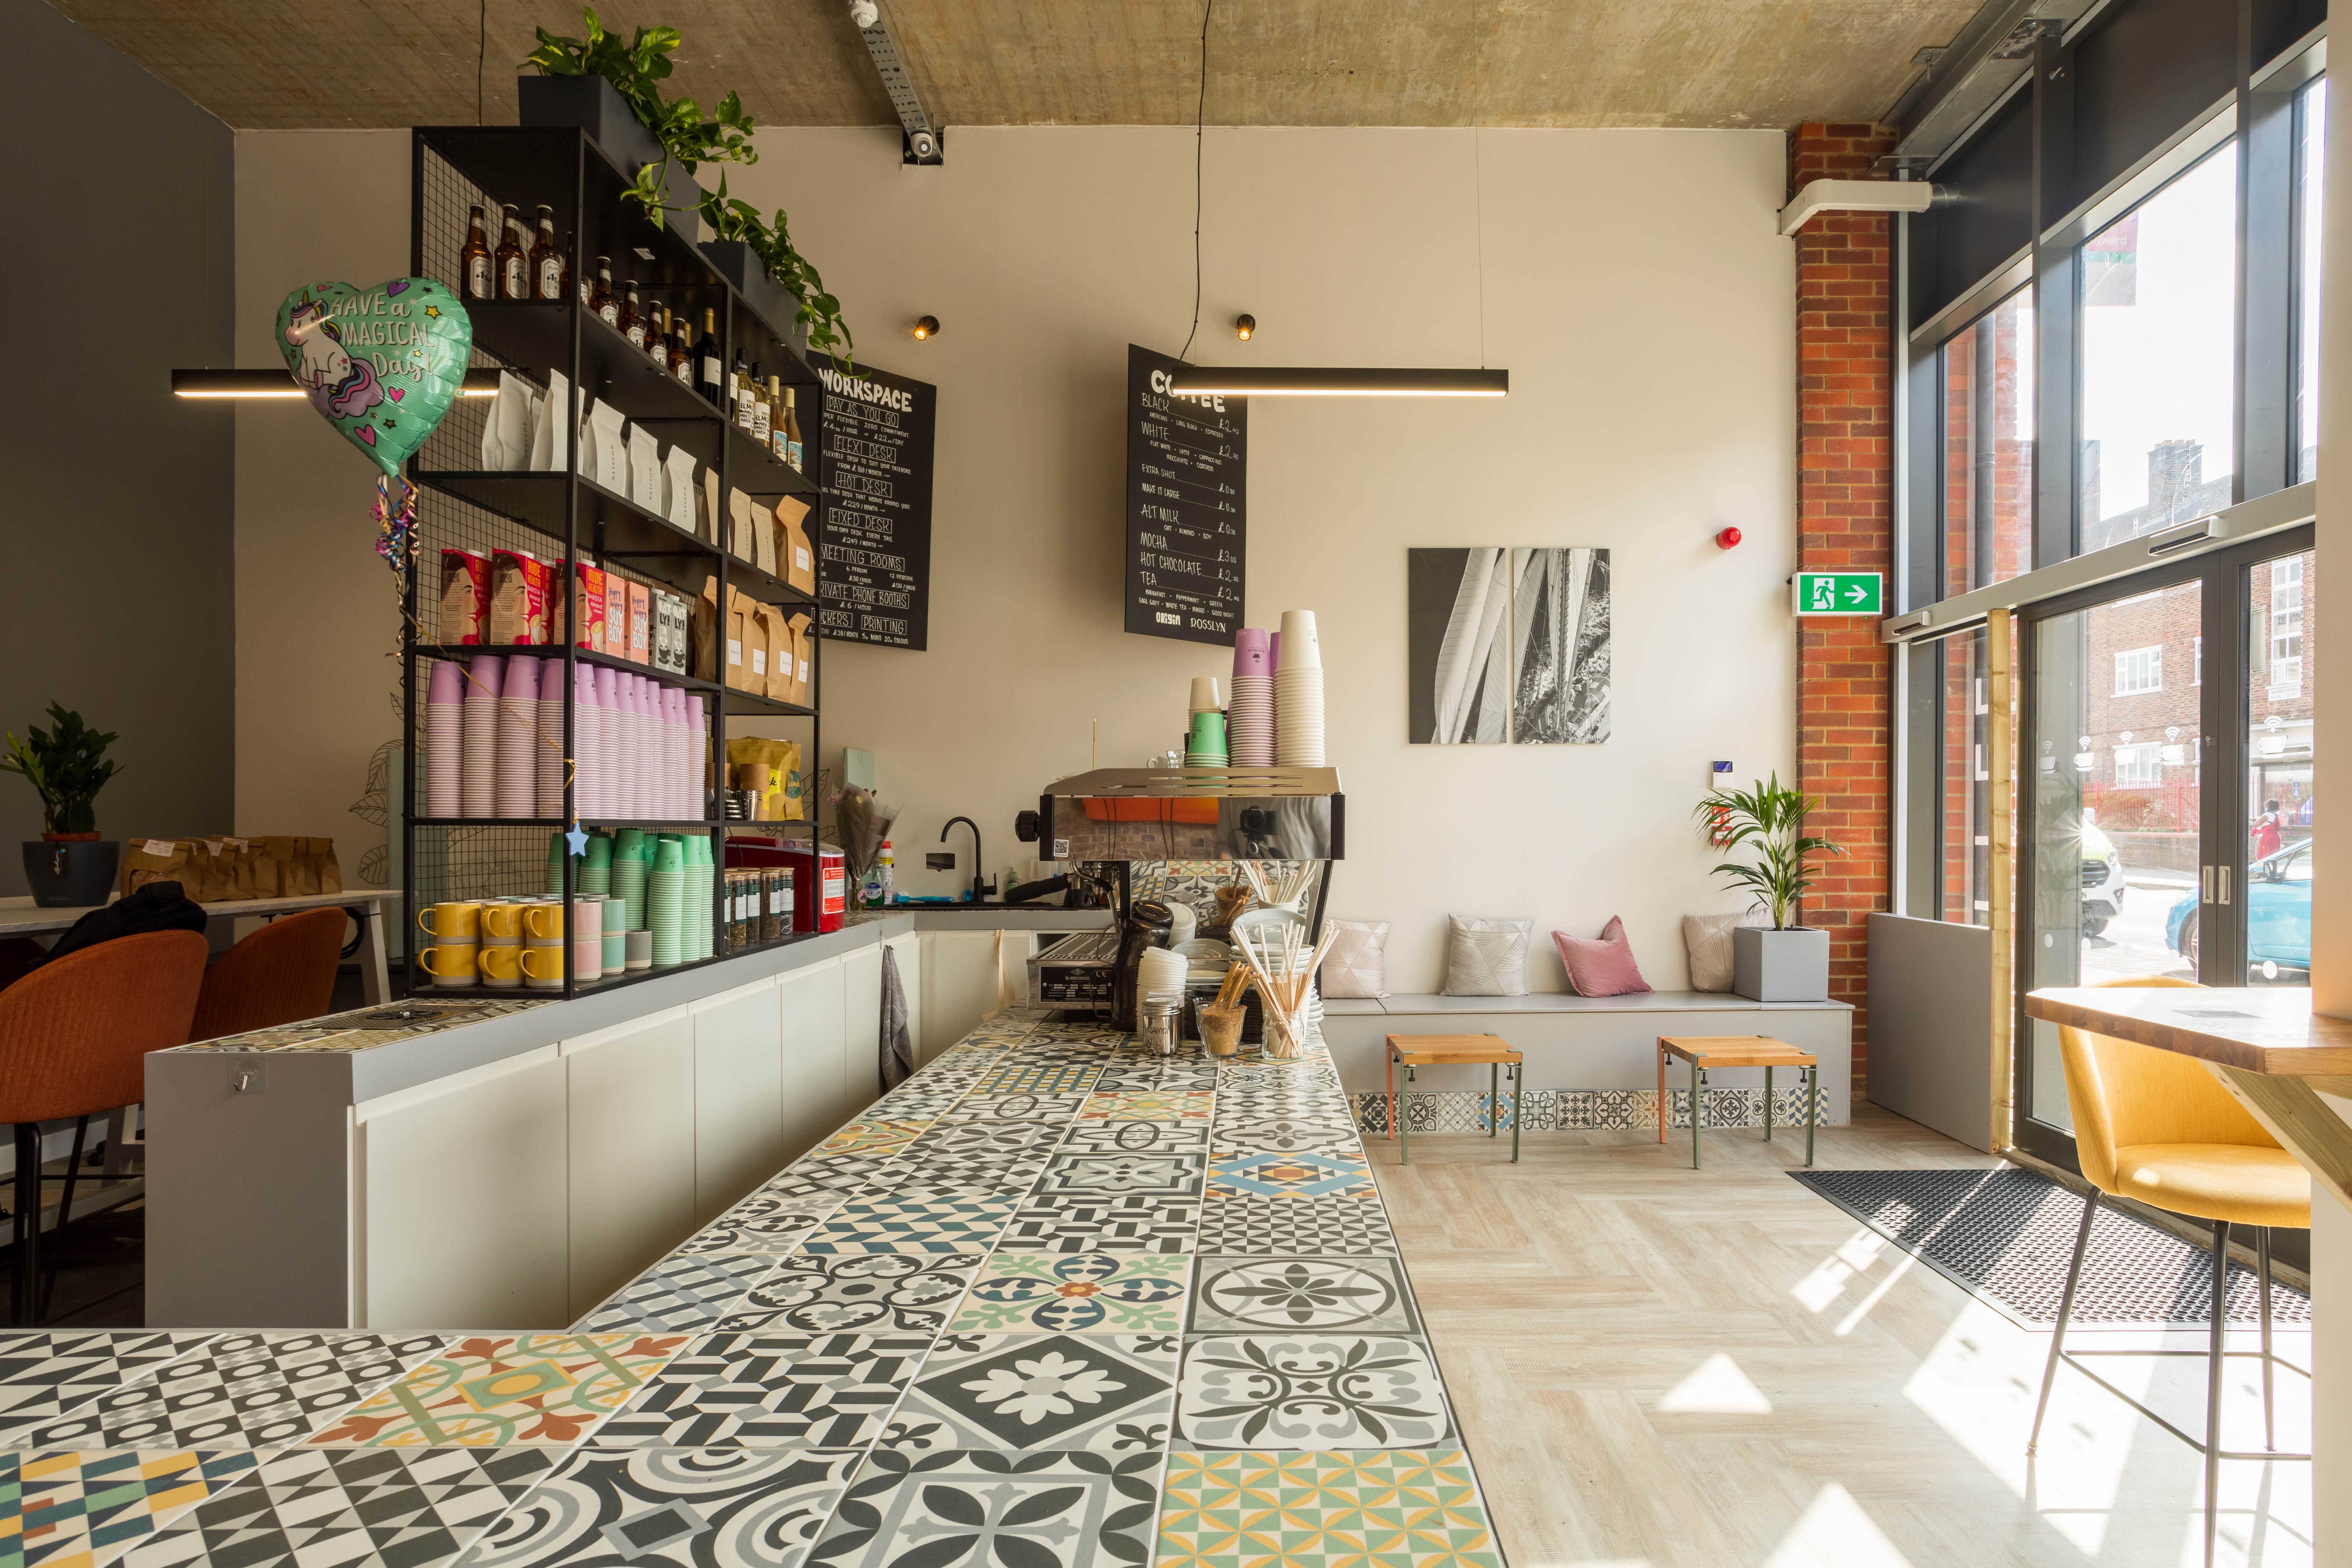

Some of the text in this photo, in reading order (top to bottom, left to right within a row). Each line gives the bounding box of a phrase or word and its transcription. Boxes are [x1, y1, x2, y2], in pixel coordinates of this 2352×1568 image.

[330, 292, 412, 317] HAVE a
[342, 321, 435, 348] MAGICAL
[372, 352, 433, 382] Day!
[818, 368, 912, 412] WORKSPACE
[1151, 370, 1225, 412] COEE
[829, 398, 896, 425] PAY AS YOU GO
[1141, 393, 1239, 434] BLACK £2.40
[881, 427, 909, 438] COMMITMENT.
[1150, 412, 1167, 422] AMERICANO
[1205, 428, 1223, 438] ESPRESSO
[837, 437, 893, 462] FLEXI DESK
[1142, 421, 1238, 459] WHITE £2.70
[823, 450, 844, 459] FLEXIBLE
[892, 465, 911, 475] CALENDAR
[1167, 454, 1213, 471] MACCHIATO CORTADO
[1199, 454, 1221, 465] CAPPUCCINO
[838, 474, 888, 496] HOT DESK
[1142, 464, 1235, 495] EXTRA SHOT £0.30
[843, 500, 860, 508] £229
[1142, 483, 1235, 513] MAKE IT LARGE £0.30
[832, 510, 889, 531] FIXED DESK
[1141, 504, 1235, 535] ALT MILK £0.30
[1179, 528, 1195, 536] ALMOND
[1141, 532, 1236, 563] MOCHA £3.00
[821, 546, 901, 570] MEETING ROOMS
[1141, 551, 1238, 582] HOT CHOCOLATE £2.70
[528, 560, 541, 578] RUDE
[589, 569, 603, 585] RUDE
[528, 574, 541, 588] HEALTH
[528, 585, 540, 595] BARISTA
[588, 583, 602, 595] HEALTH
[1140, 571, 1239, 601] TEA £2.40
[529, 594, 541, 602] Almond
[588, 593, 602, 603] BARISTA
[609, 587, 621, 602] Happy
[632, 596, 644, 610] Happy
[821, 582, 906, 607] RIVATE PHONE BOOTHS
[1145, 589, 1165, 597] BREAKFAST
[1176, 594, 1199, 603] PEPPERMINT
[590, 601, 602, 609] Almond
[610, 598, 622, 614] happy
[634, 607, 646, 622] happy
[609, 607, 623, 627] SOY
[633, 615, 647, 634] SOY
[660, 613, 670, 626] LY!
[864, 616, 904, 634] PRINTING
[1191, 618, 1225, 633] ROSSLYN
[608, 624, 622, 644] BOY
[633, 631, 647, 650] BOY
